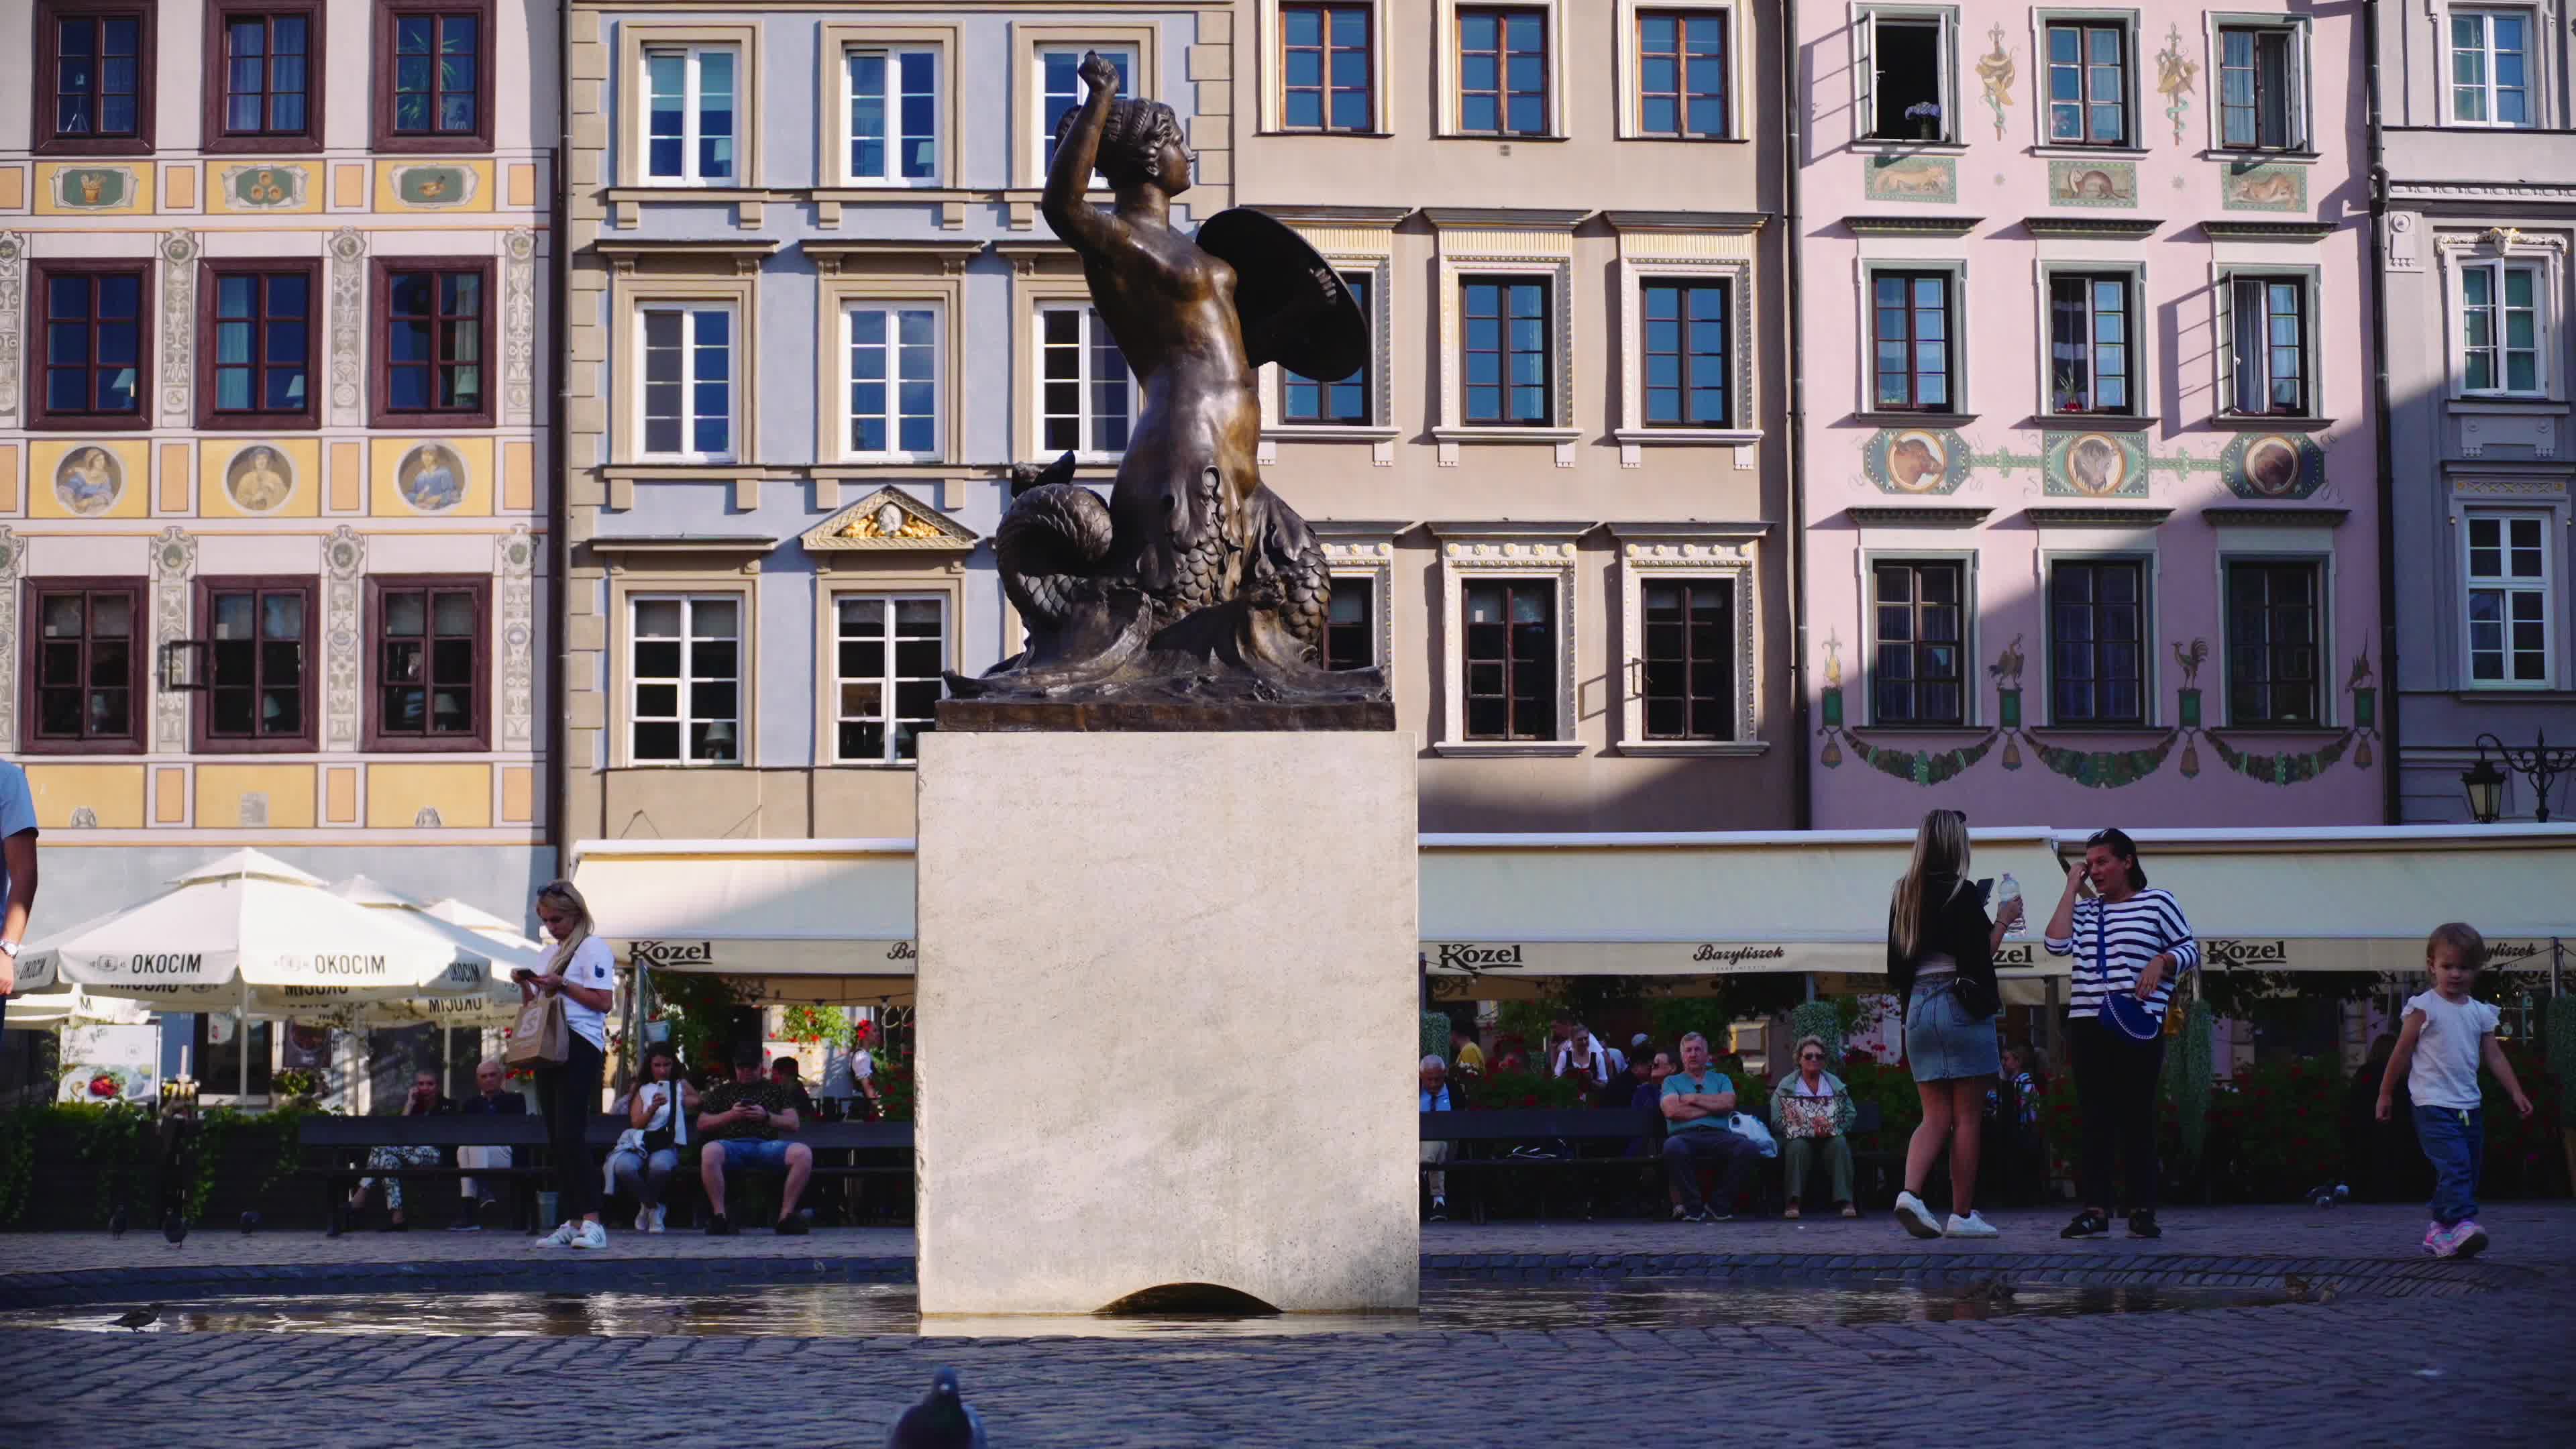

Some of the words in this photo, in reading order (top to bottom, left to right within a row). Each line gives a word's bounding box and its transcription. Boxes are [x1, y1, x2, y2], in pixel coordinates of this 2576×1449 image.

[131, 953, 202, 973] OKOCIM
[315, 955, 386, 974] OKOCIM
[628, 941, 712, 967] Kozel
[1438, 944, 1524, 970] Kozel
[1693, 944, 1785, 965] Bazyliszek
[1994, 945, 2034, 967] zel
[2206, 940, 2287, 967] Kozel
[19, 957, 47, 980] OKOCIM
[447, 963, 480, 982] OKOCIM
